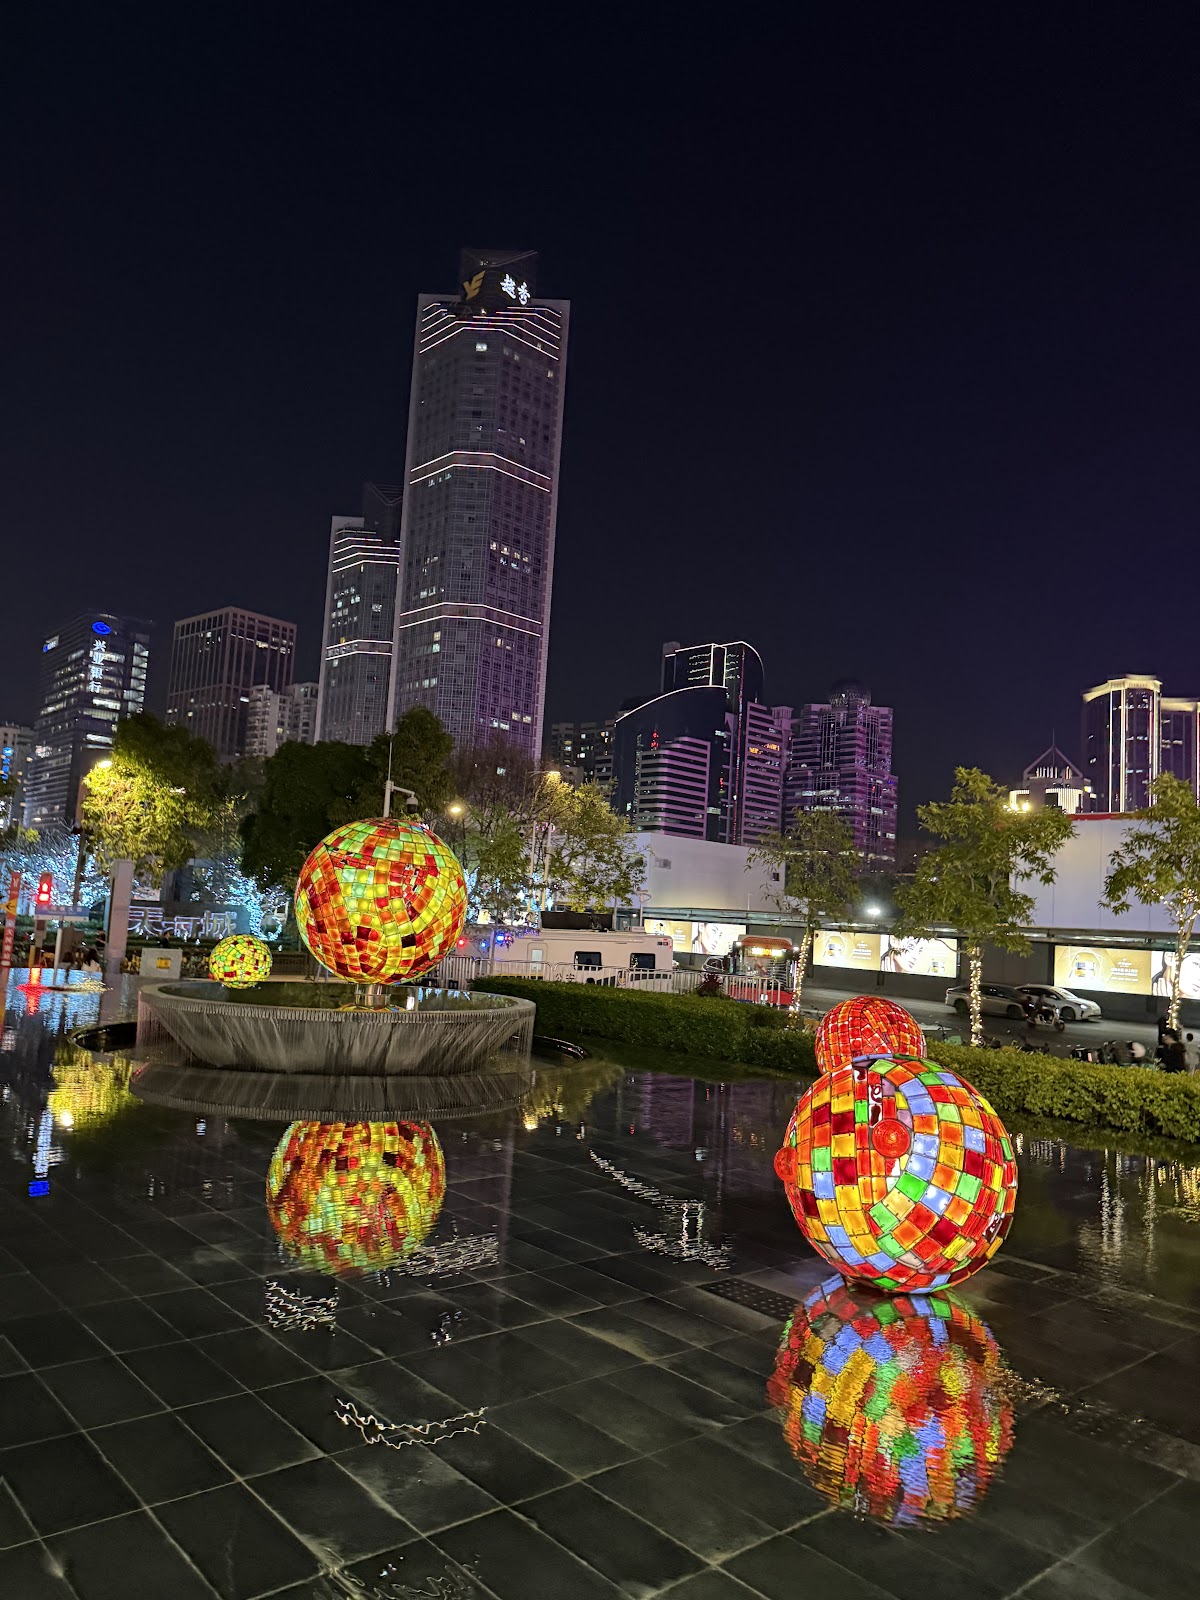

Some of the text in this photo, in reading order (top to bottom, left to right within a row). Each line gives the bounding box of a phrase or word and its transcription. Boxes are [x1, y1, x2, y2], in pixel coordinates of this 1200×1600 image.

[500, 273, 531, 305] 越秀
[89, 639, 106, 694] 兴业银行
[128, 905, 237, 938] 天河城
